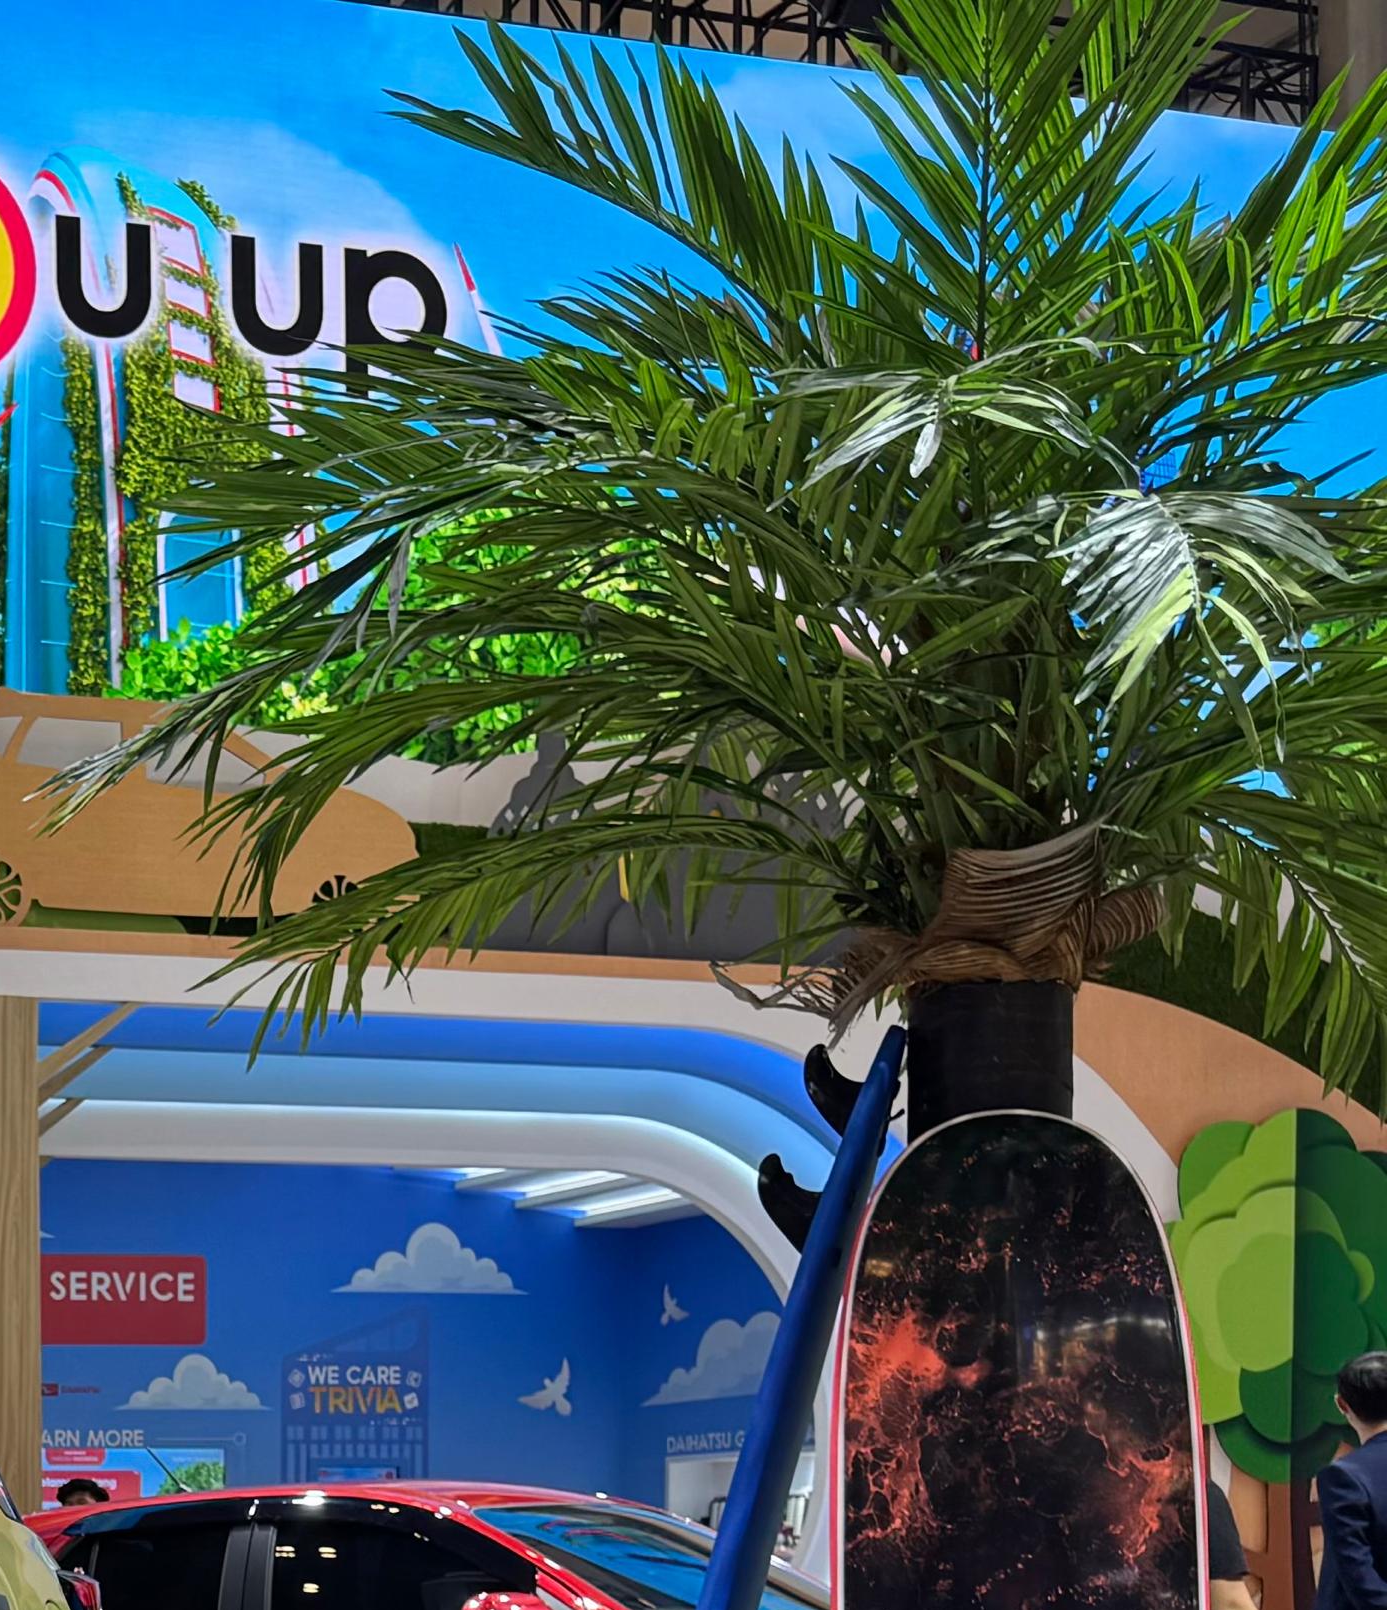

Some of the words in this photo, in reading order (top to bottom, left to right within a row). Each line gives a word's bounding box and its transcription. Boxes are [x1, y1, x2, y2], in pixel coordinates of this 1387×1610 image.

[230, 233, 447, 400] up
[49, 1271, 195, 1302] SERVICE
[308, 1365, 340, 1385] WE
[345, 1365, 402, 1385] CARE
[308, 1386, 403, 1415] TRIVIA
[86, 1429, 145, 1447] MORE
[665, 1432, 732, 1453] DAIHATSU
